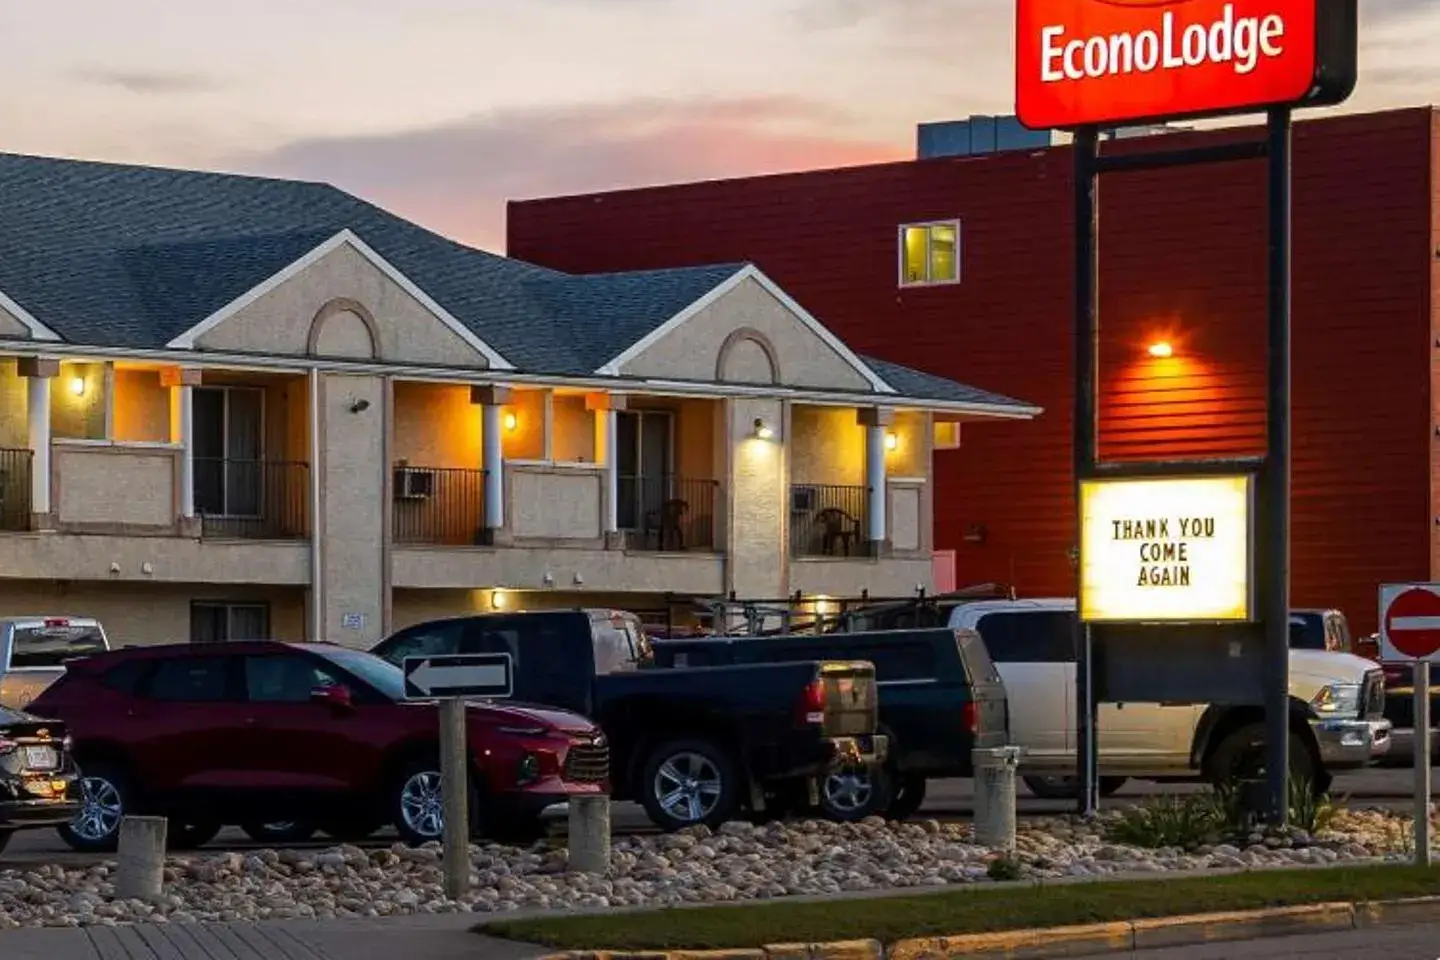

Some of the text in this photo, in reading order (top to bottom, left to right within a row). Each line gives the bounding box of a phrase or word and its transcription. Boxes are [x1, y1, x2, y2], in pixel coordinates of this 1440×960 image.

[1040, 3, 1285, 82] EconoLodge
[1112, 517, 1215, 540] THANK YOU
[1139, 542, 1188, 562] COME
[1136, 566, 1191, 586] AGAIN
